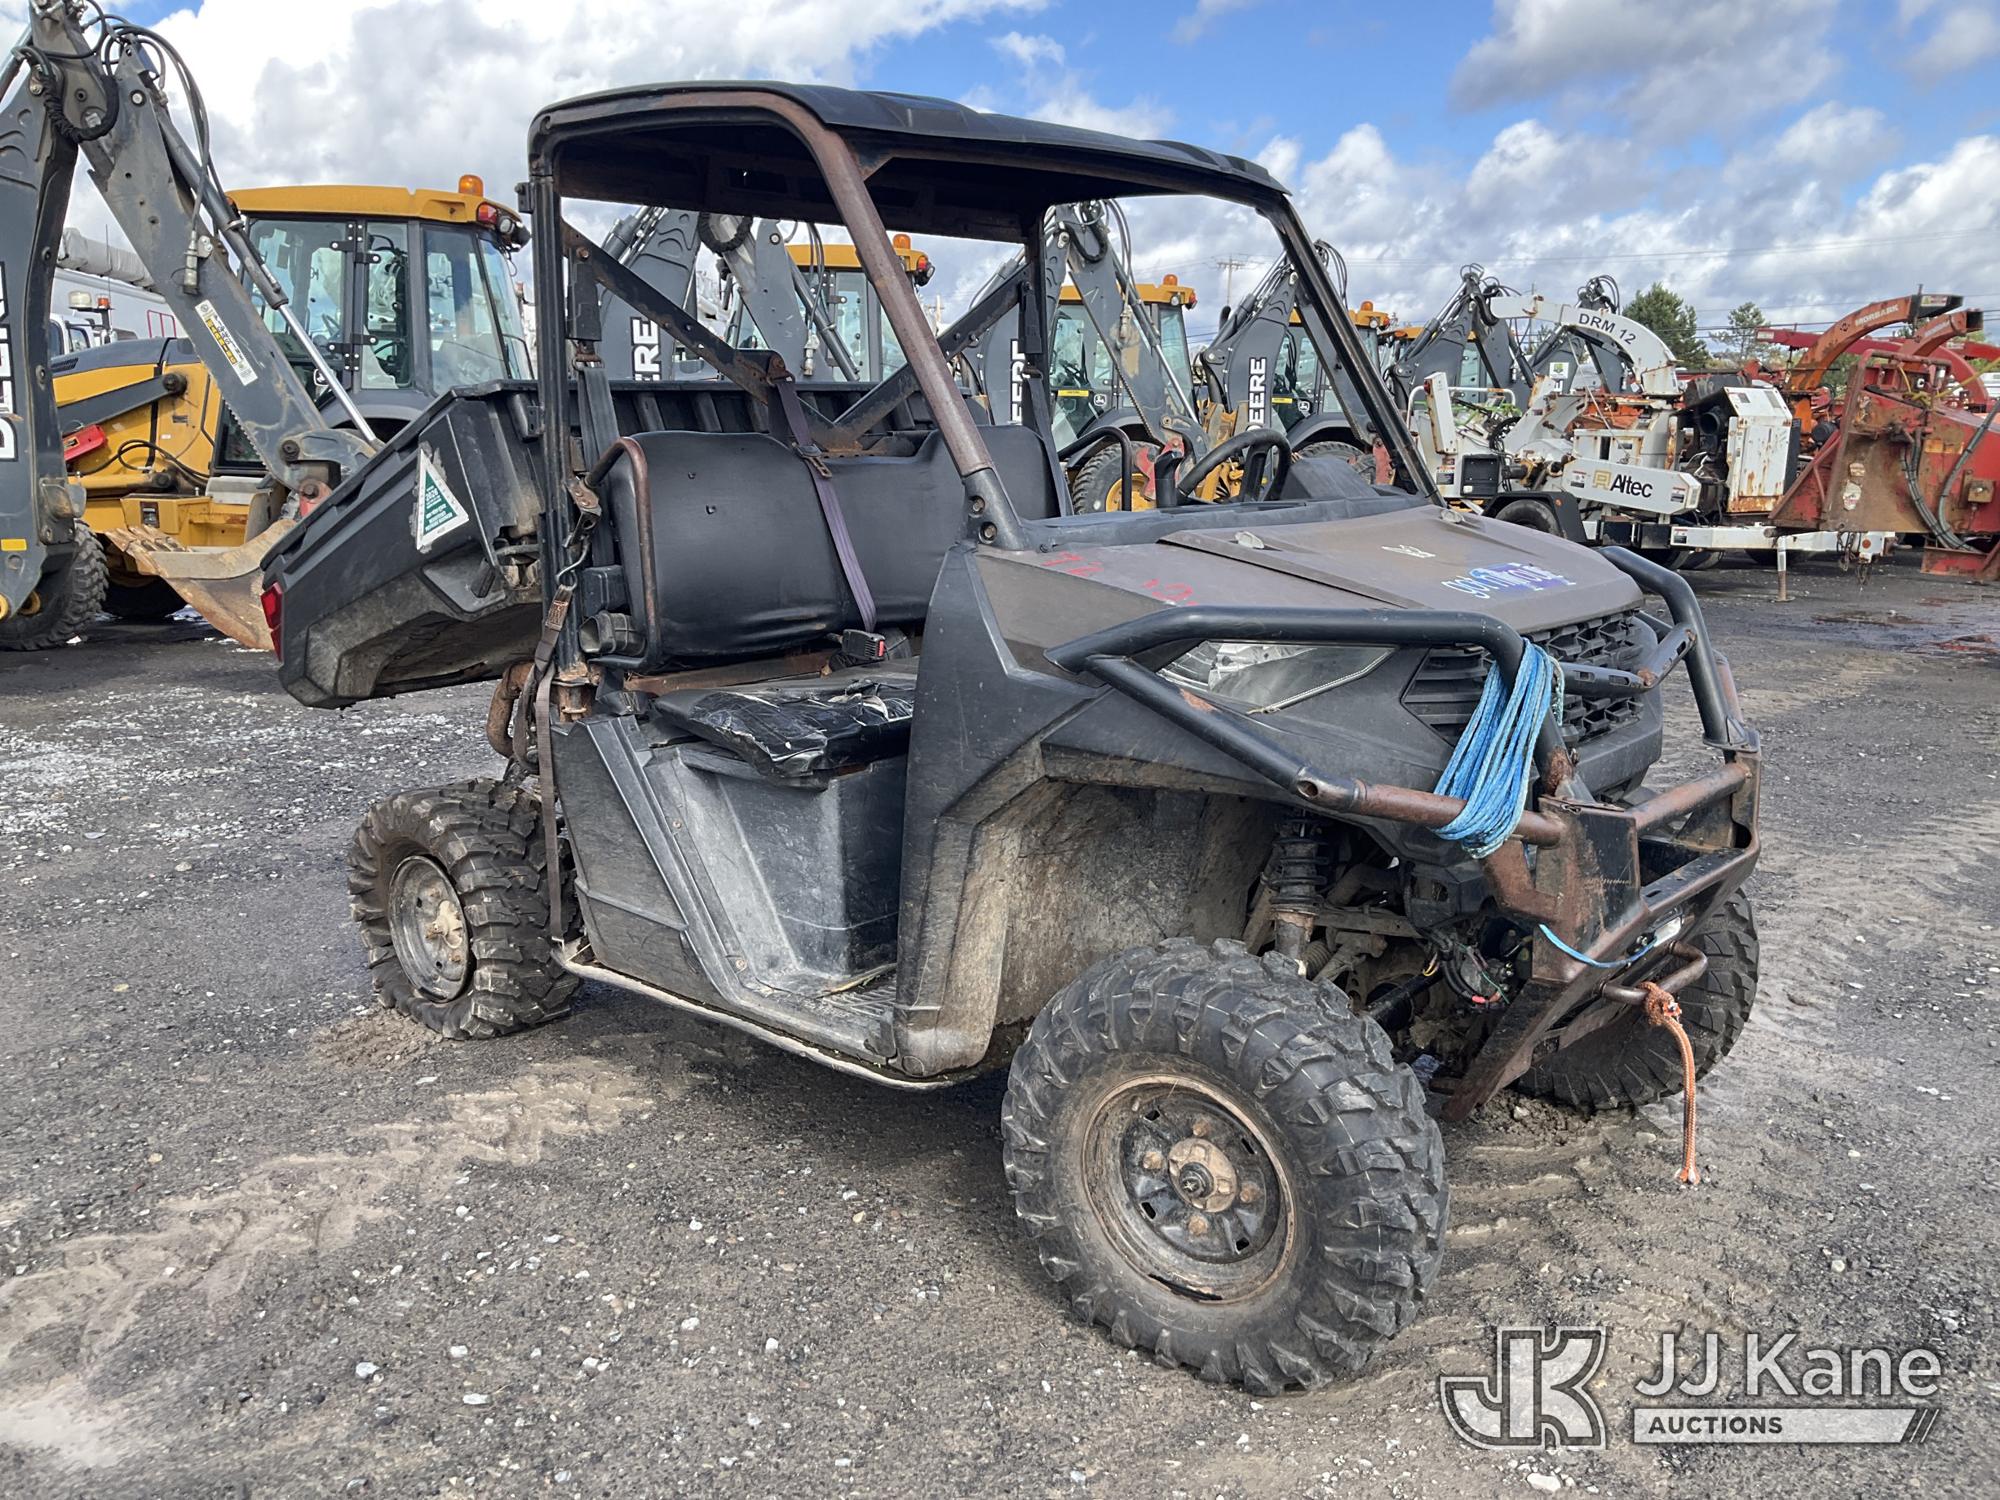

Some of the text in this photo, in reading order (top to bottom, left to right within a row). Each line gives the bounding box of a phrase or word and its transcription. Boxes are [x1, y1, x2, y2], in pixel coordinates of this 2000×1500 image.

[1578, 313, 1637, 345] DRM 12
[1609, 474, 1654, 499] Altec
